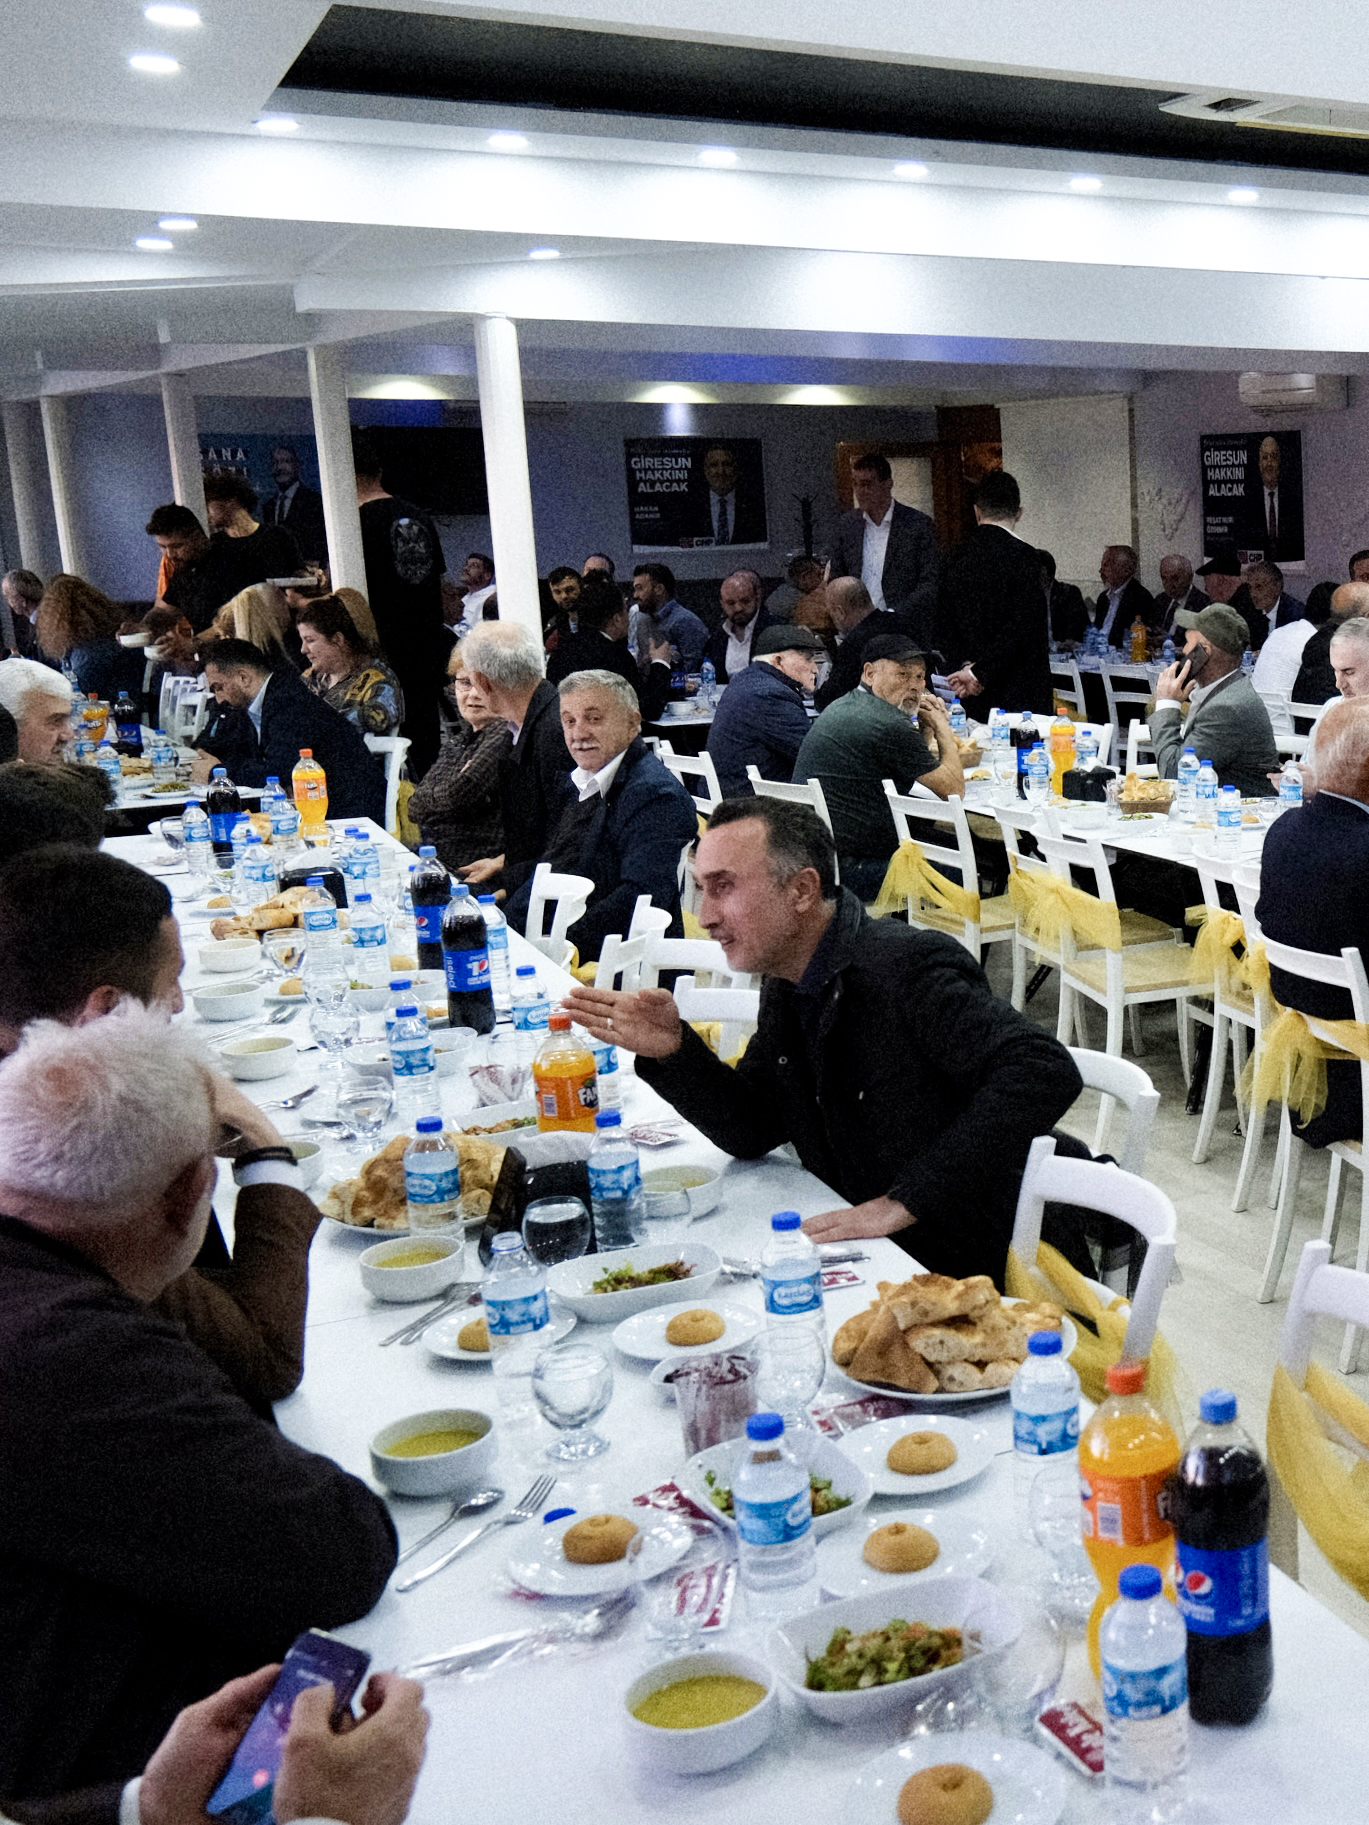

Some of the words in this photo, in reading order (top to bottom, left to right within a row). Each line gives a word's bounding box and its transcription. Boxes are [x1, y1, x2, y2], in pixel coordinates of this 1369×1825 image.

[631, 455, 692, 469] GİRESUN
[1204, 448, 1247, 466] GİRESUN
[636, 470, 688, 480] HAKKINI
[1207, 467, 1244, 480] HAKKINI
[637, 482, 688, 493] ALACAK
[1208, 483, 1245, 496] ALACAK
[695, 538, 713, 547] CHP
